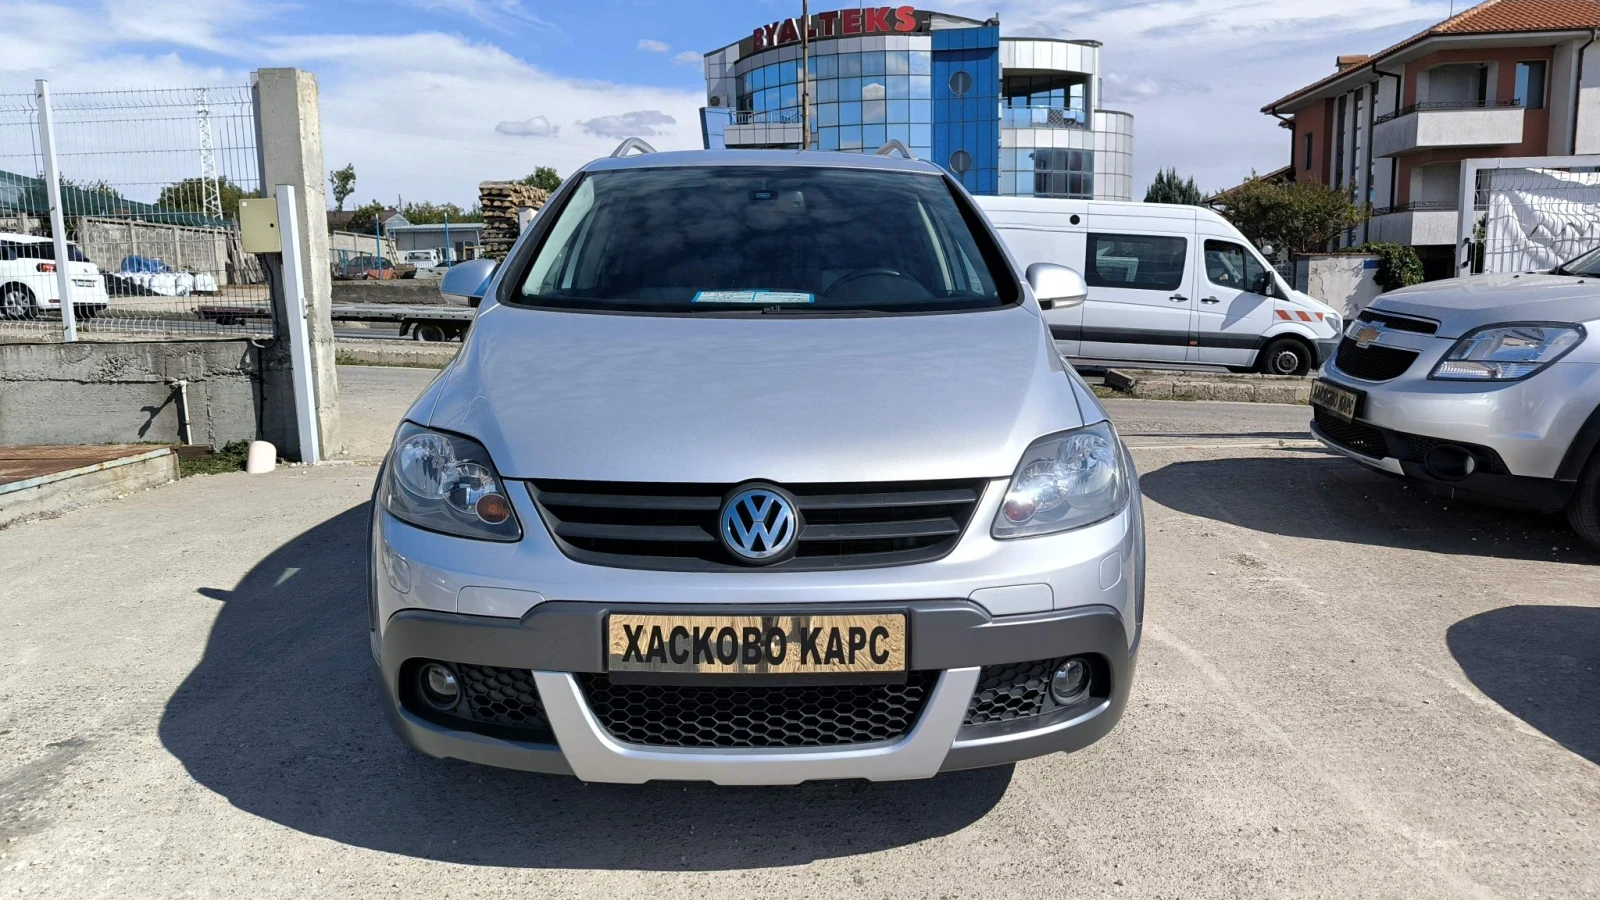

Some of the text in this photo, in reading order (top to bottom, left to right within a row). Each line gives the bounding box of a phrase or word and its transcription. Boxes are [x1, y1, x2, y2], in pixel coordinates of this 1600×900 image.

[723, 490, 794, 558] VW
[622, 624, 890, 665] ХАСКОВО КАРС
